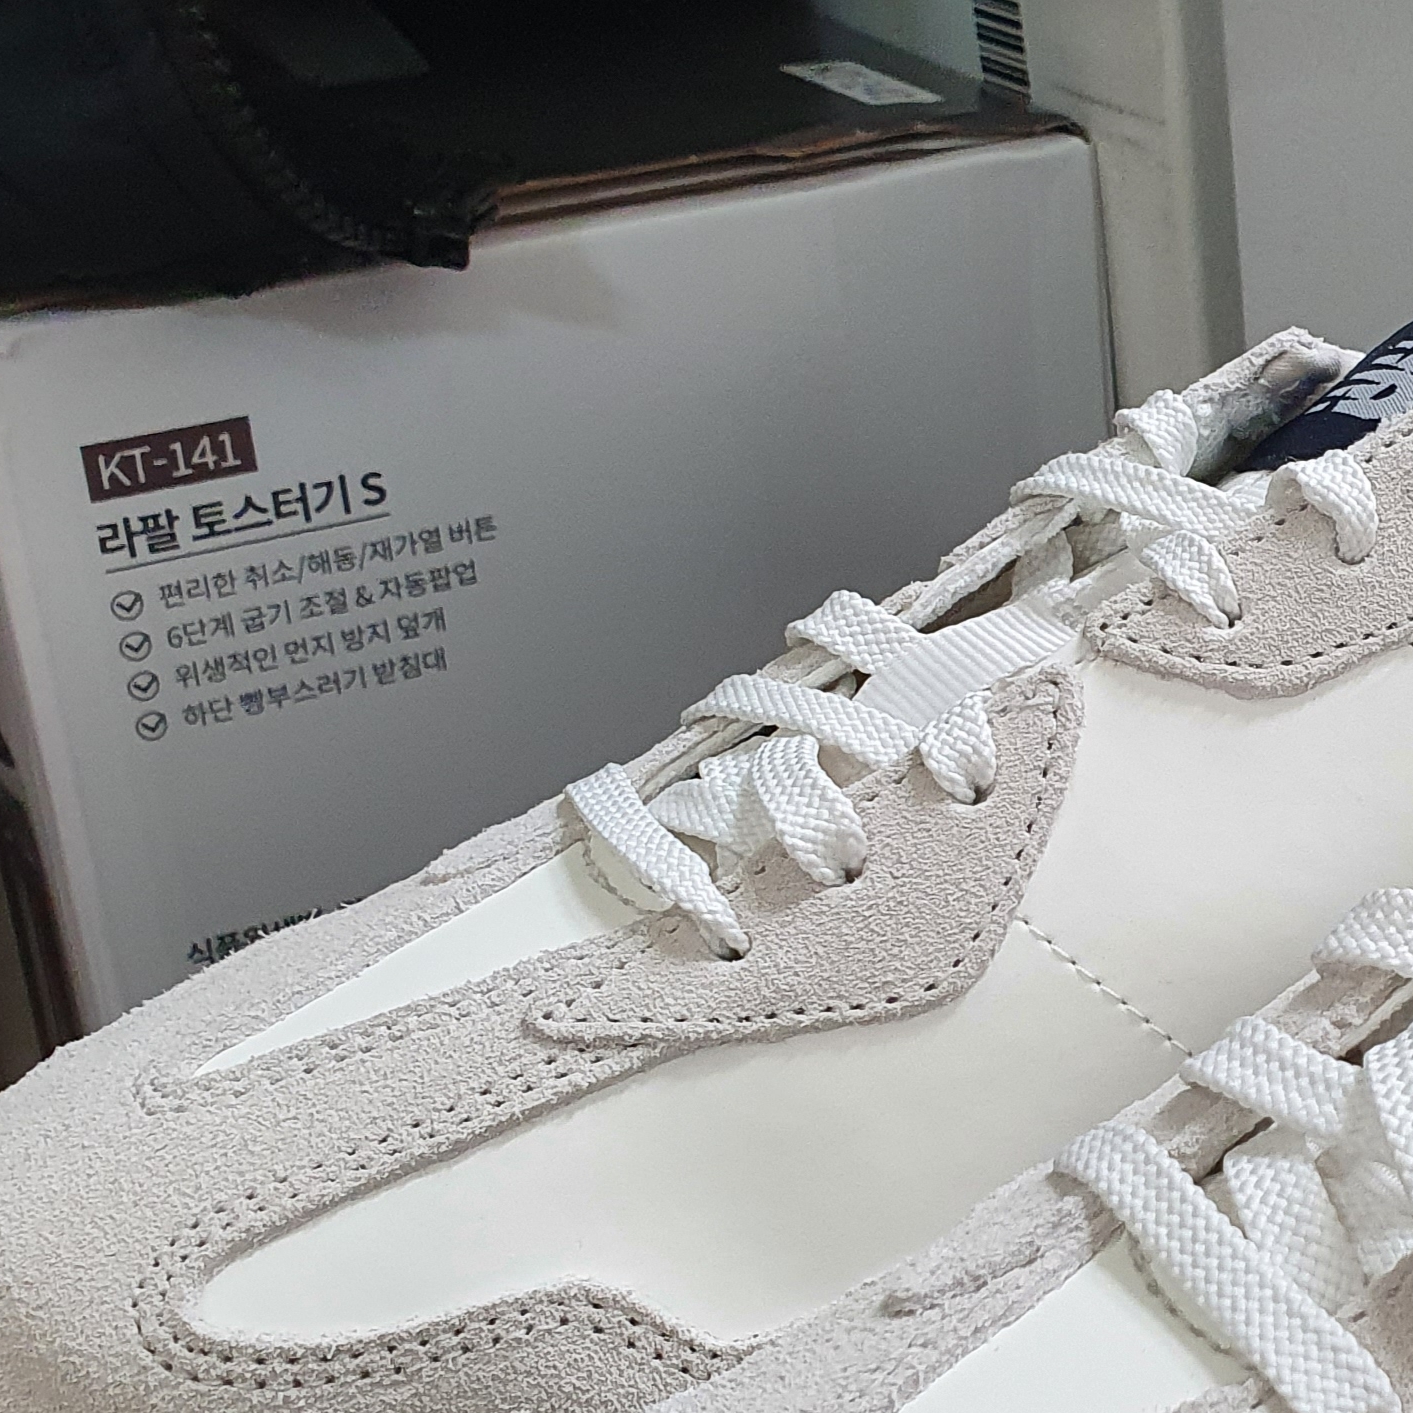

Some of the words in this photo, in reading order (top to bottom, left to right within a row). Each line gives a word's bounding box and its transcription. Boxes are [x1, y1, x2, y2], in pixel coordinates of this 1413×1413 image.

[98, 433, 241, 490] KT-141
[95, 509, 181, 558] 라팔
[192, 473, 352, 542] 토스터기
[360, 472, 387, 507] S
[158, 569, 237, 609] 편리한
[244, 526, 444, 589] 취소/해동/재가열
[448, 514, 497, 545] 버튼
[167, 612, 235, 648] 6단계
[241, 600, 292, 634] 굽기
[299, 587, 348, 620] 조절
[355, 585, 376, 608] &
[379, 559, 477, 600] 자동팝업
[175, 643, 278, 688] 위생적인
[284, 632, 335, 664] 먼지
[340, 619, 391, 652] 방지
[397, 607, 446, 640] 덮개
[182, 695, 233, 726] 하단
[239, 666, 367, 715] 빵부스러기
[372, 646, 447, 685] 받침대
